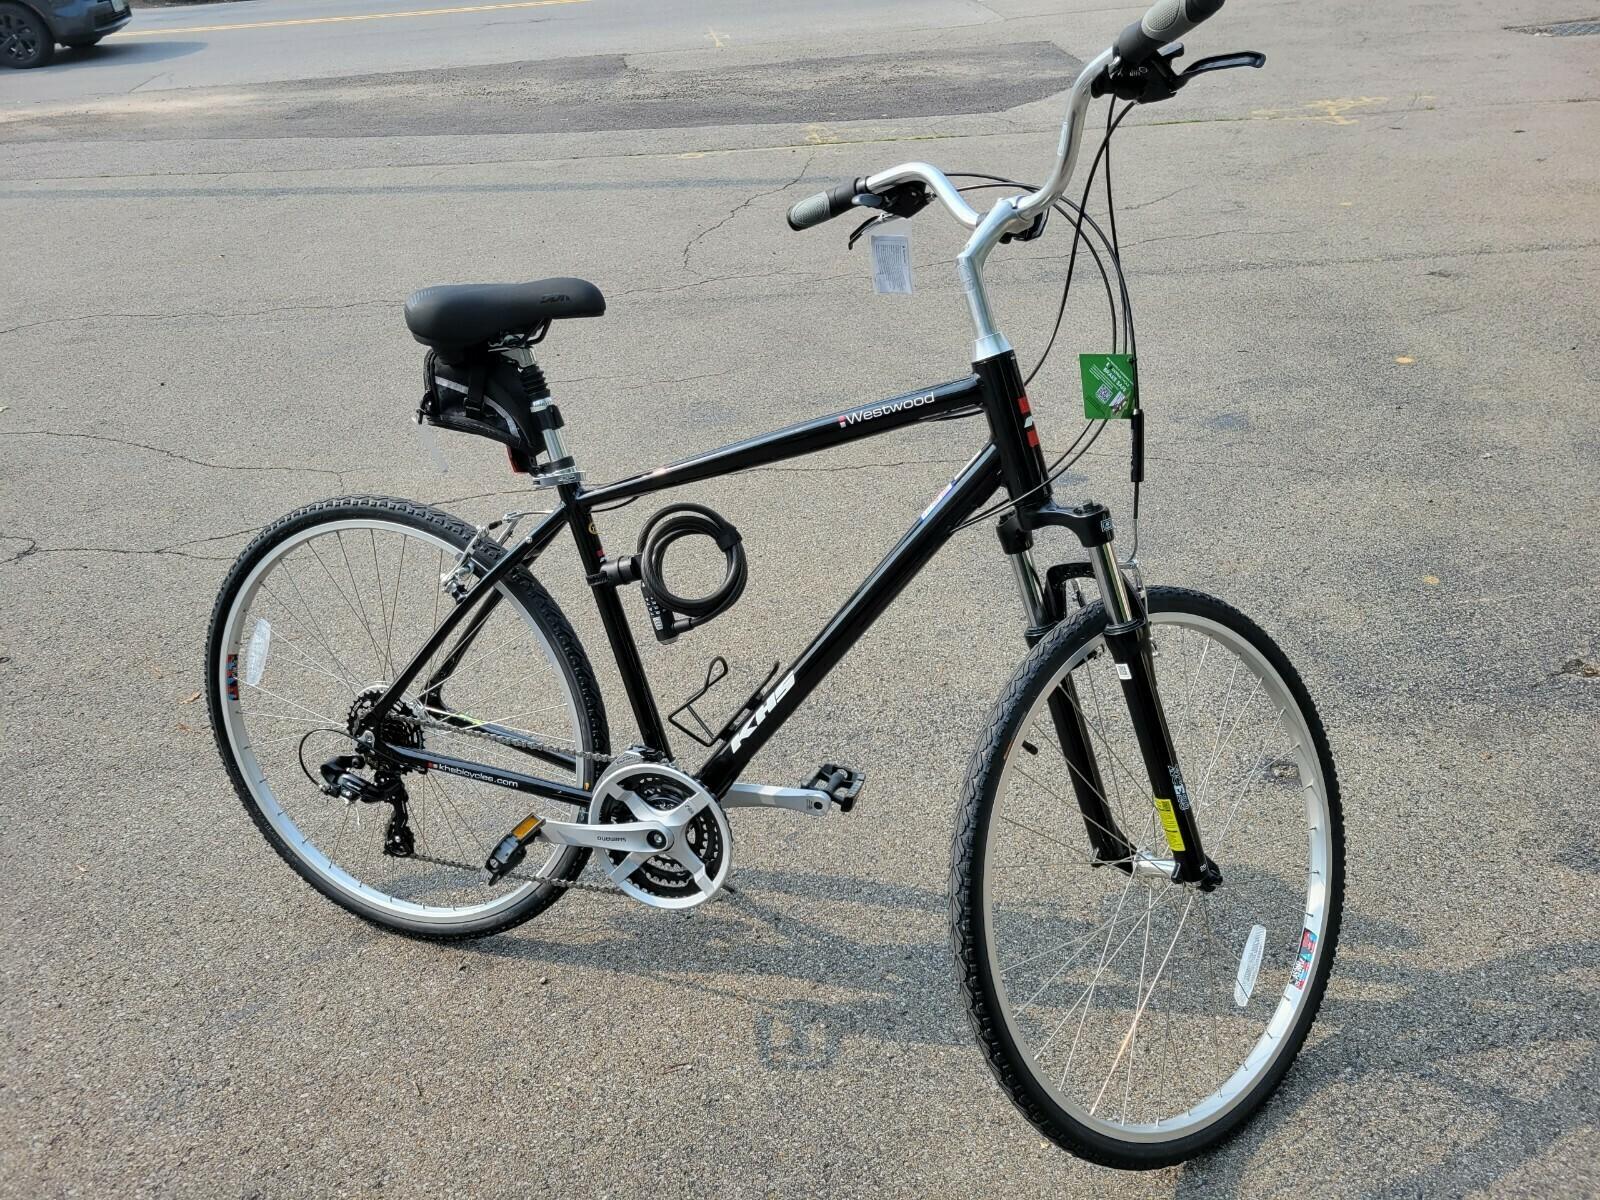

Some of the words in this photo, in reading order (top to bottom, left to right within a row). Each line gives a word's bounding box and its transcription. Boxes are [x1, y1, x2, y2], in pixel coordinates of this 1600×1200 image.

[846, 392, 935, 424] Westwood
[731, 670, 795, 754] KHS
[439, 764, 518, 788] khsbicycles.com
